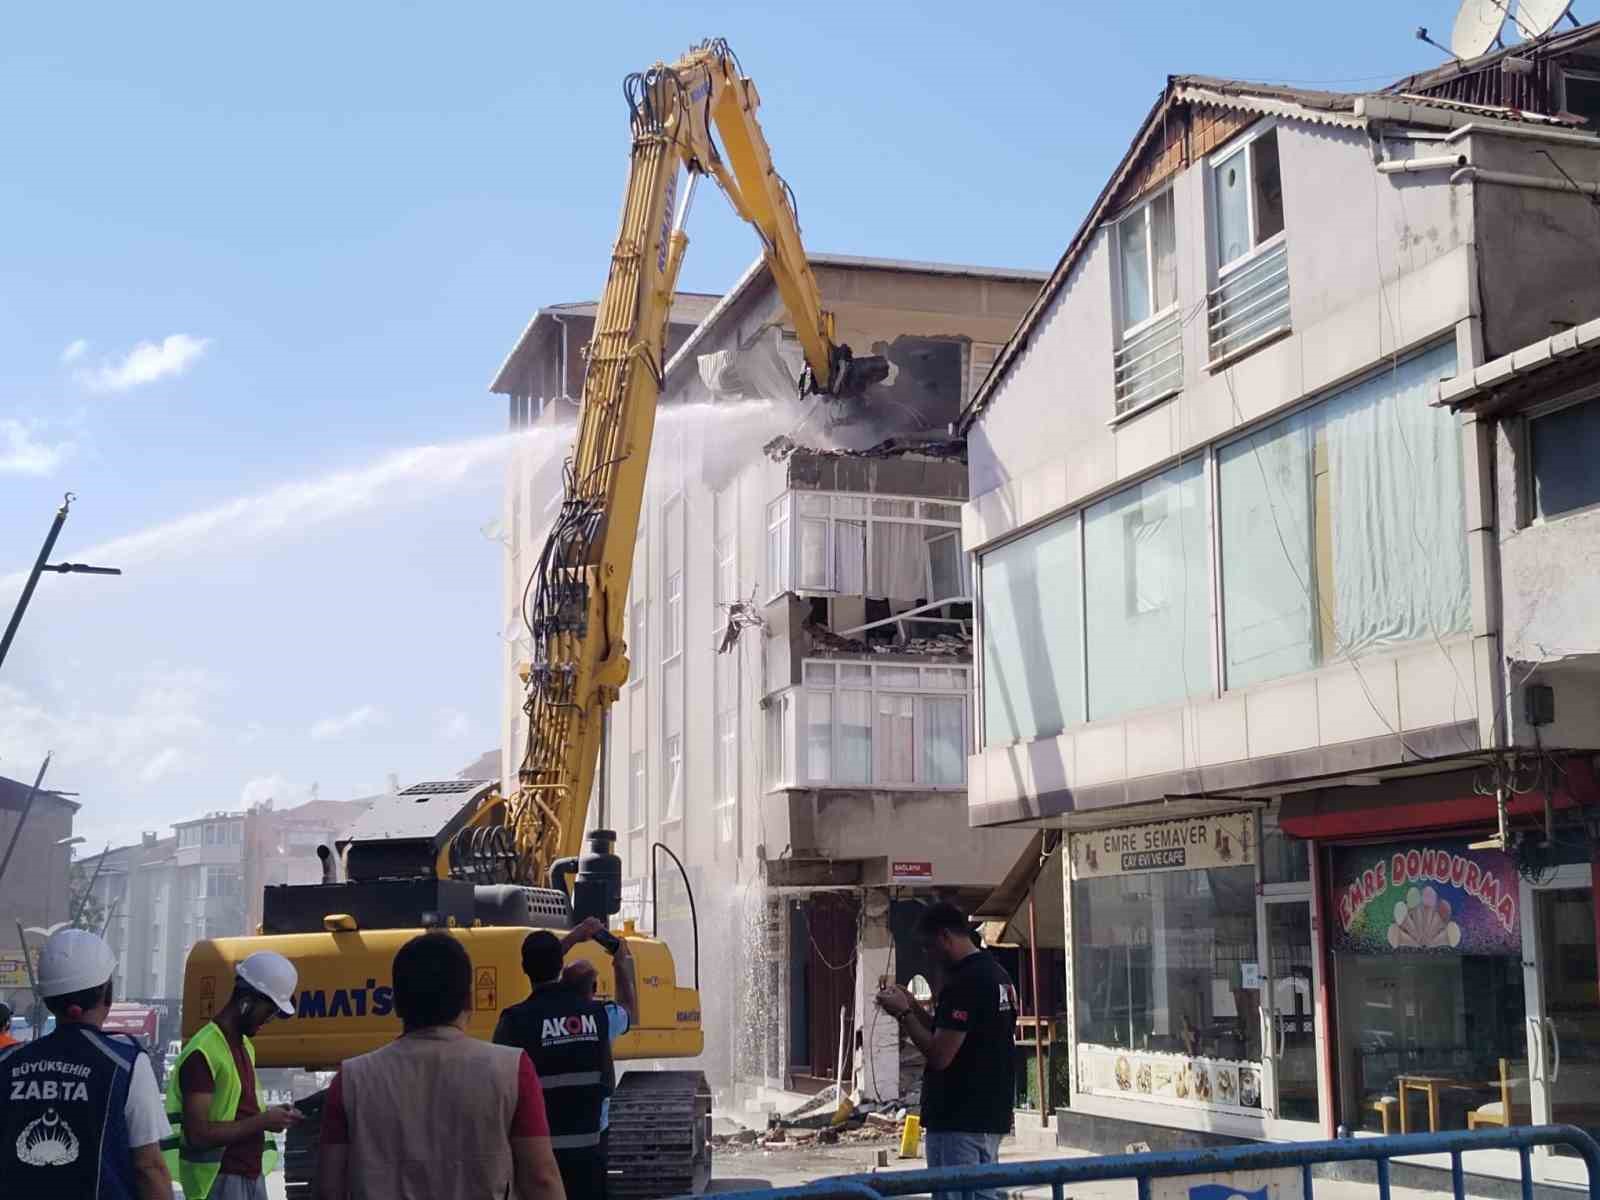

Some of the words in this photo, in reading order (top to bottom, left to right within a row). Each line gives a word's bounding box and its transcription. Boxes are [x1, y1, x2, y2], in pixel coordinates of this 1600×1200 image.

[1104, 836, 1136, 852] EMRE
[1144, 825, 1207, 849] SEMAVER
[1340, 859, 1388, 932] EMRE
[1392, 848, 1515, 933] DONDURMA
[542, 1014, 598, 1039] AKOM
